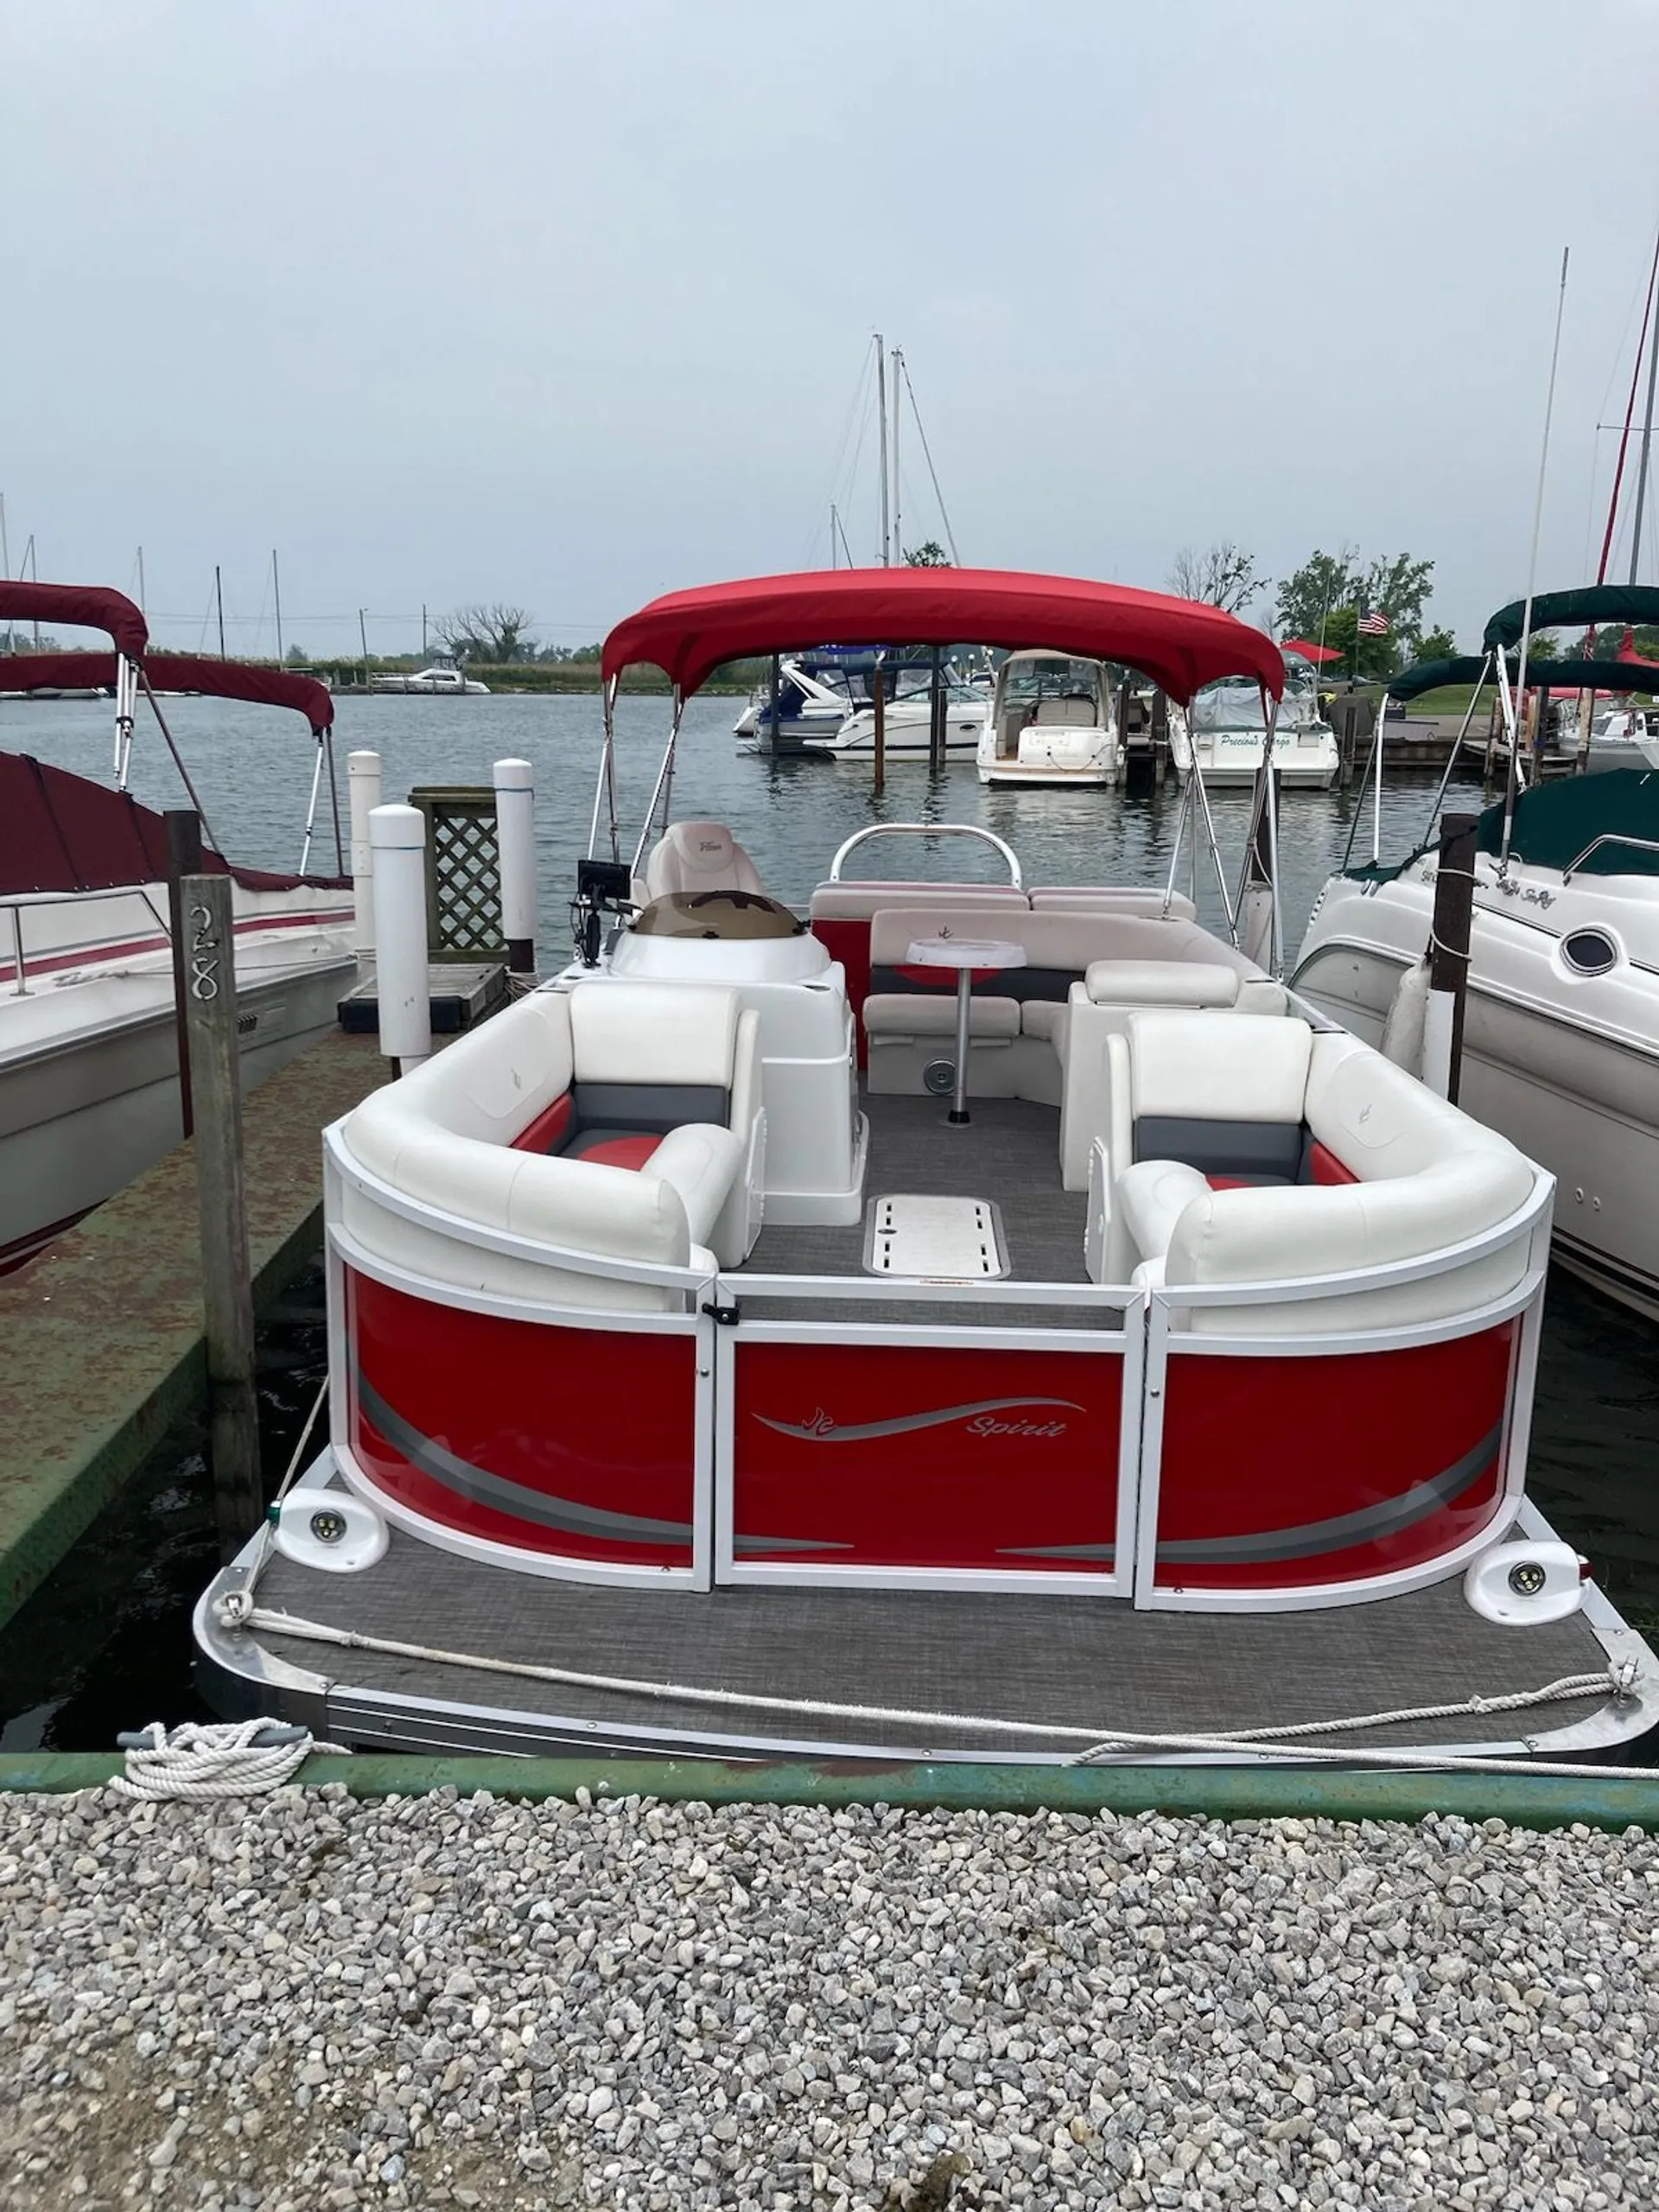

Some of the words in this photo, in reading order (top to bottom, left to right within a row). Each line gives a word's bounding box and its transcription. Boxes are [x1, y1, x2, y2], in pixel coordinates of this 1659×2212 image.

[1262, 734, 1290, 749] Crgo
[190, 906, 219, 1001] 28
[966, 1415, 1068, 1437] Spirit
